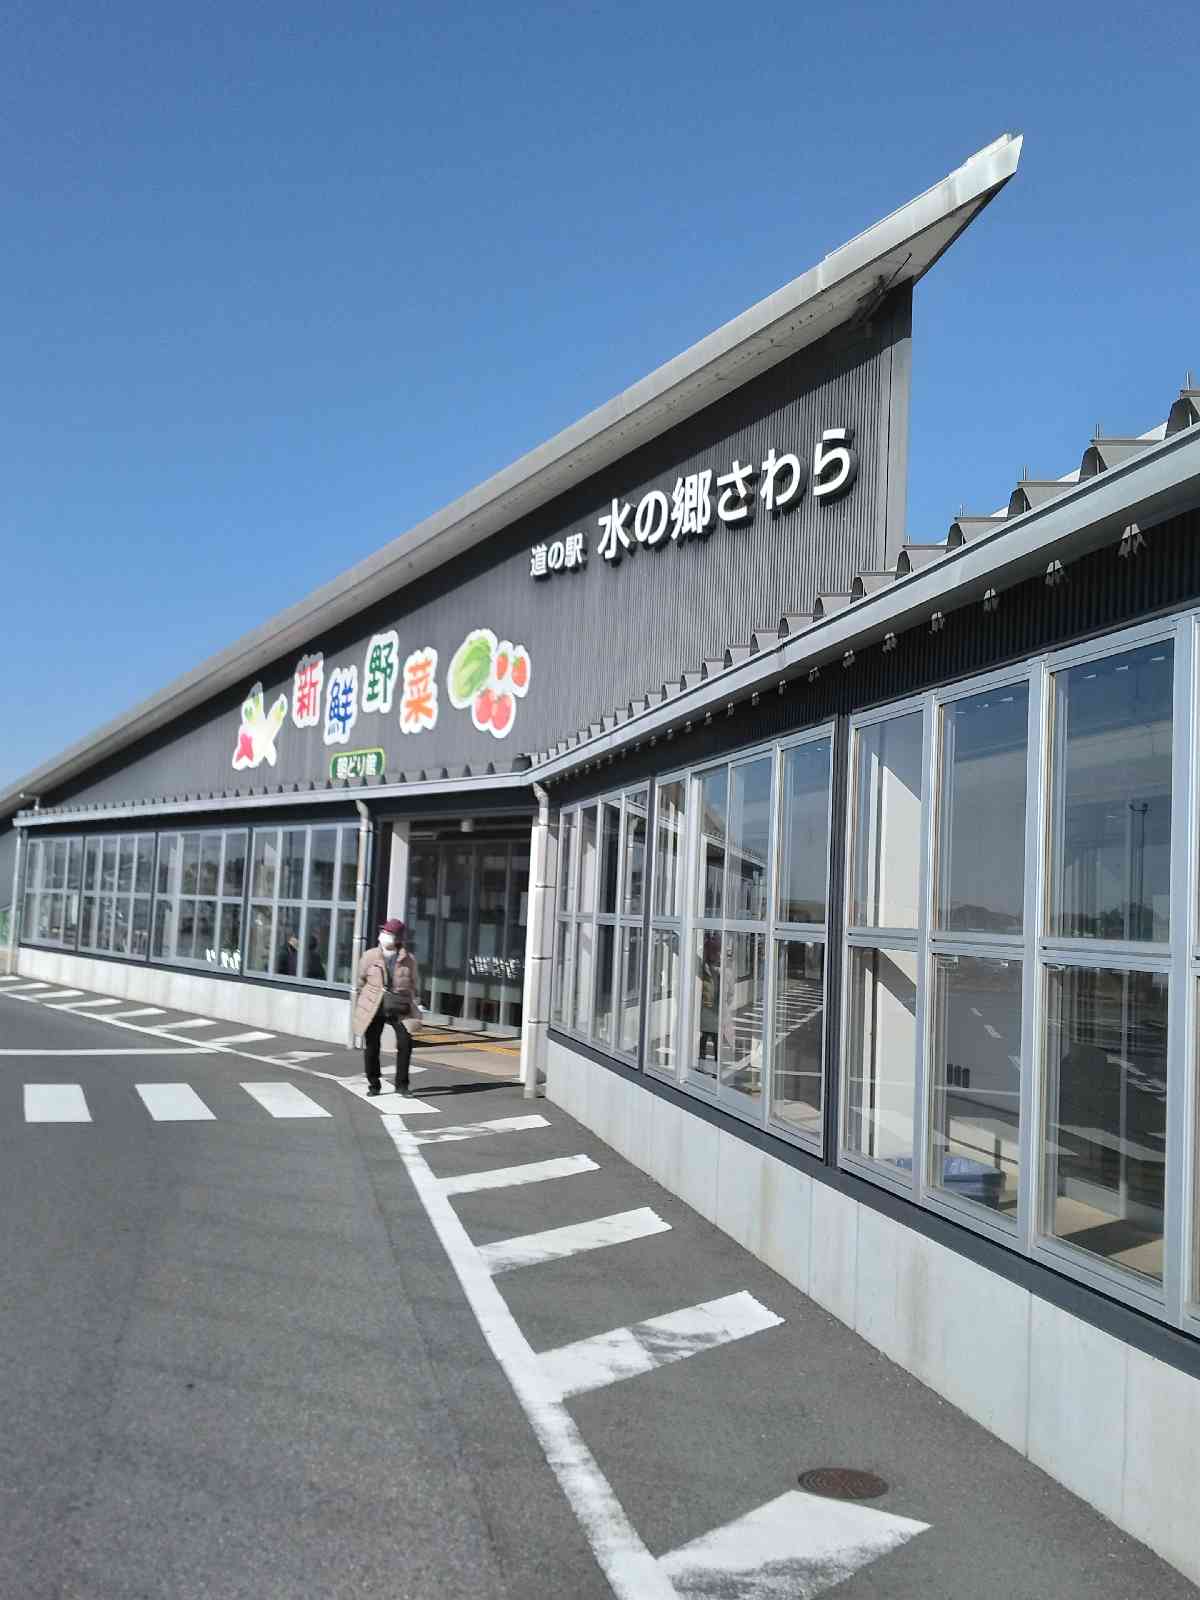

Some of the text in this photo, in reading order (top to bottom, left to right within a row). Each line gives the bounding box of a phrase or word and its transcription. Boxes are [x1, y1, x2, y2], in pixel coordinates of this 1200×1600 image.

[530, 428, 850, 577] 道の駅 水の郷さわら
[294, 635, 436, 740] 新鮮野菜
